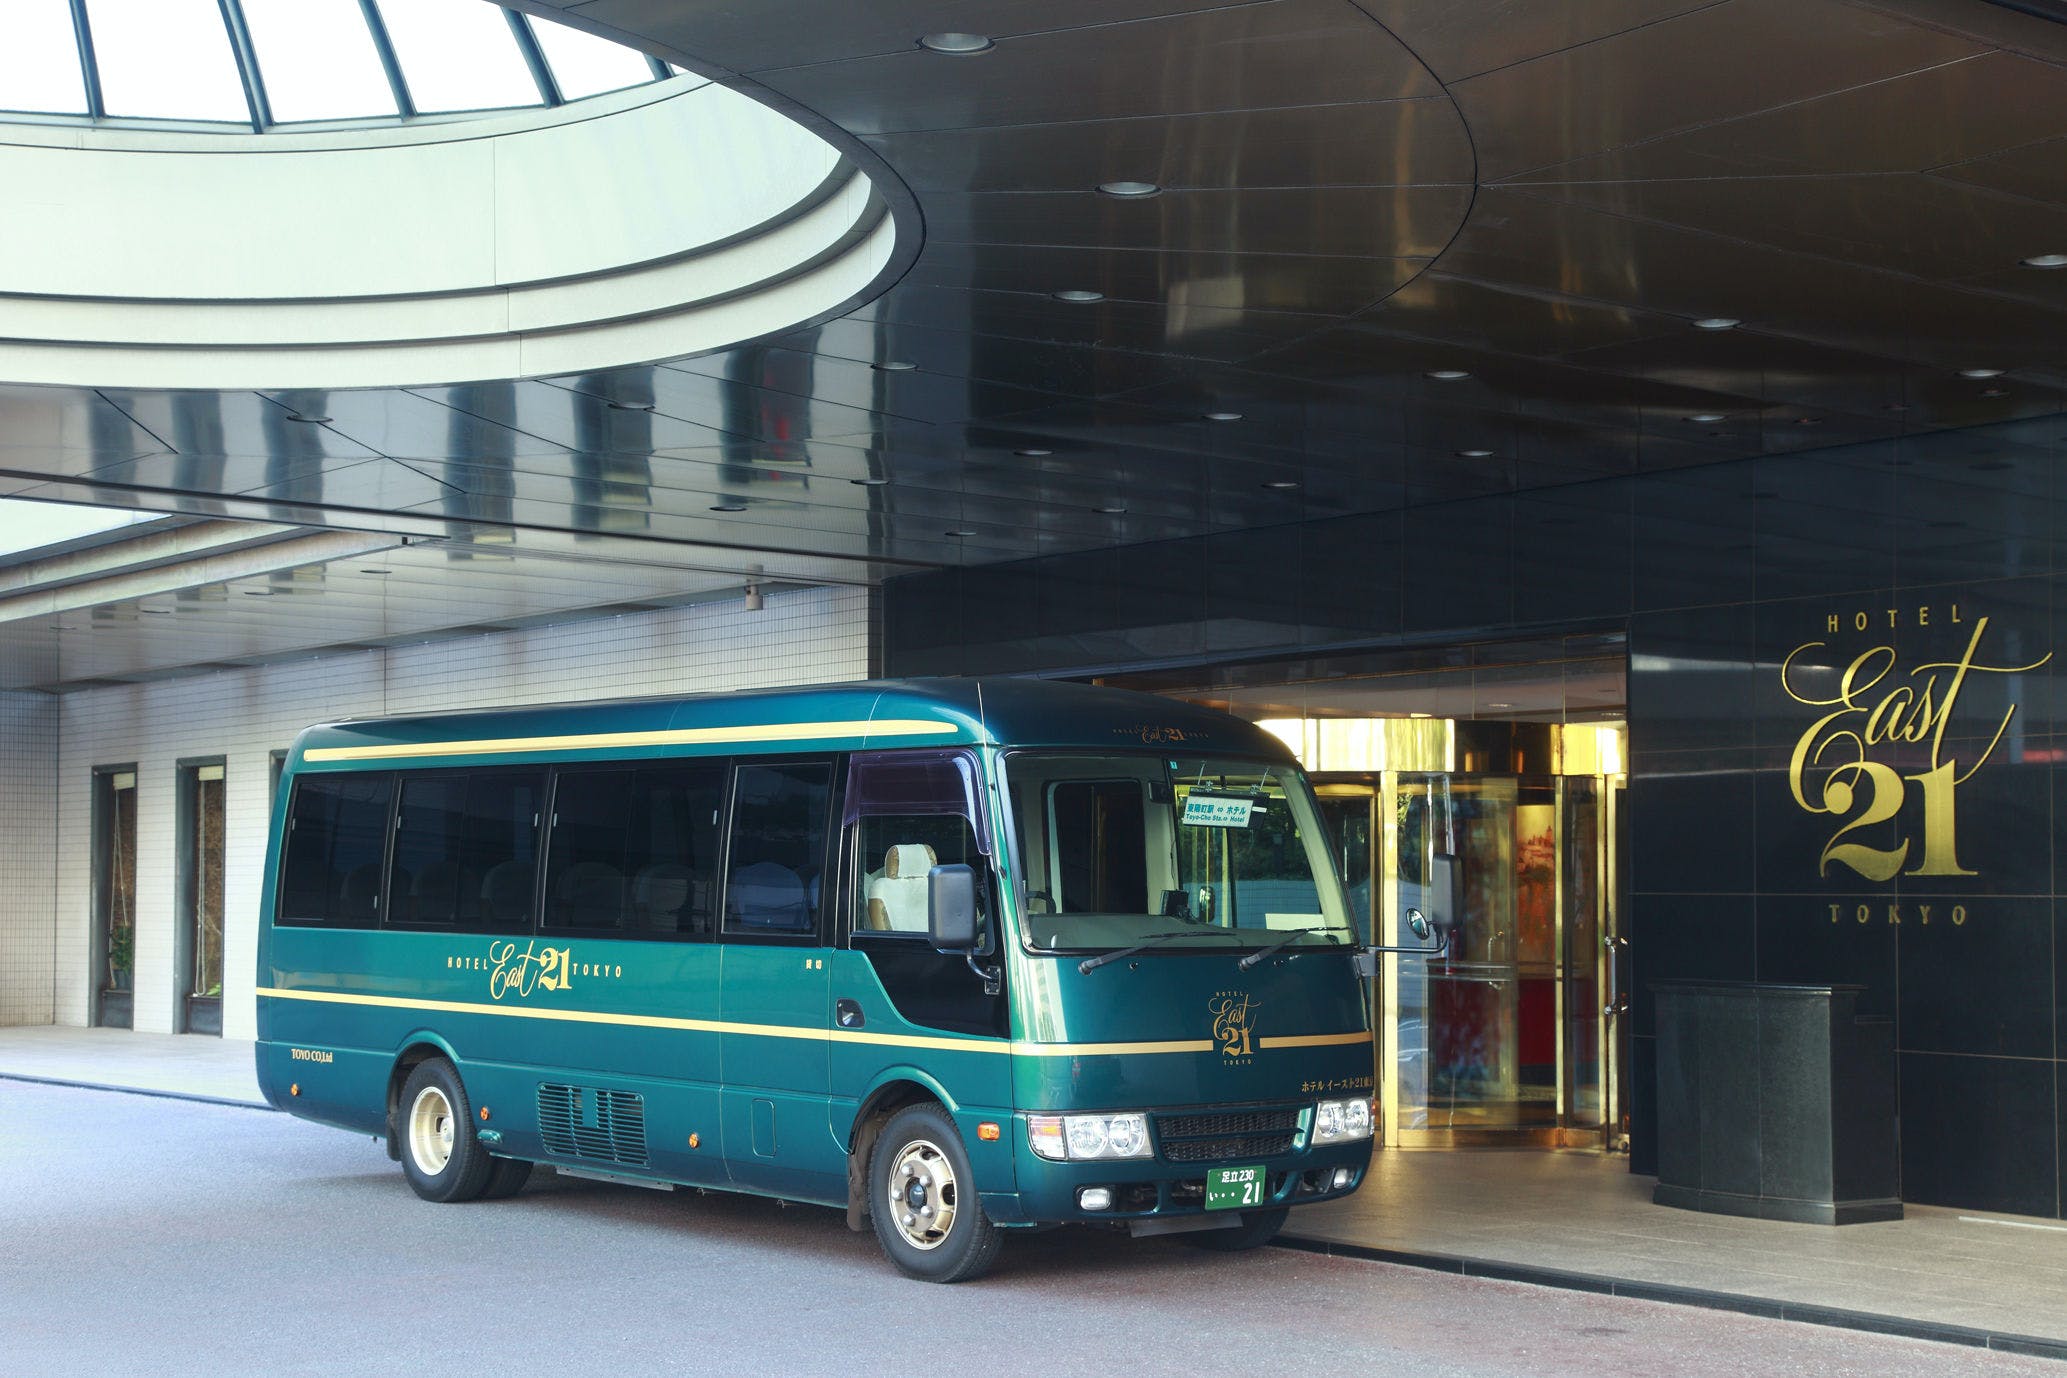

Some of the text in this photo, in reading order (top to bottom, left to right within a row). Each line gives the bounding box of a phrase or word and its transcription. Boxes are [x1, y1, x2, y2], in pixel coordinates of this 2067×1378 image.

[1828, 604, 1961, 632] HOTEL
[1782, 617, 2053, 813] East
[1226, 806, 1246, 816] ホテル
[1820, 759, 1978, 882] 21
[1829, 904, 1966, 926] TOKYO
[448, 940, 622, 999] HOTEL East 21 TOKYO
[1209, 994, 1262, 1040] East
[291, 1048, 310, 1060] TOYO
[1222, 1027, 1254, 1057] 21
